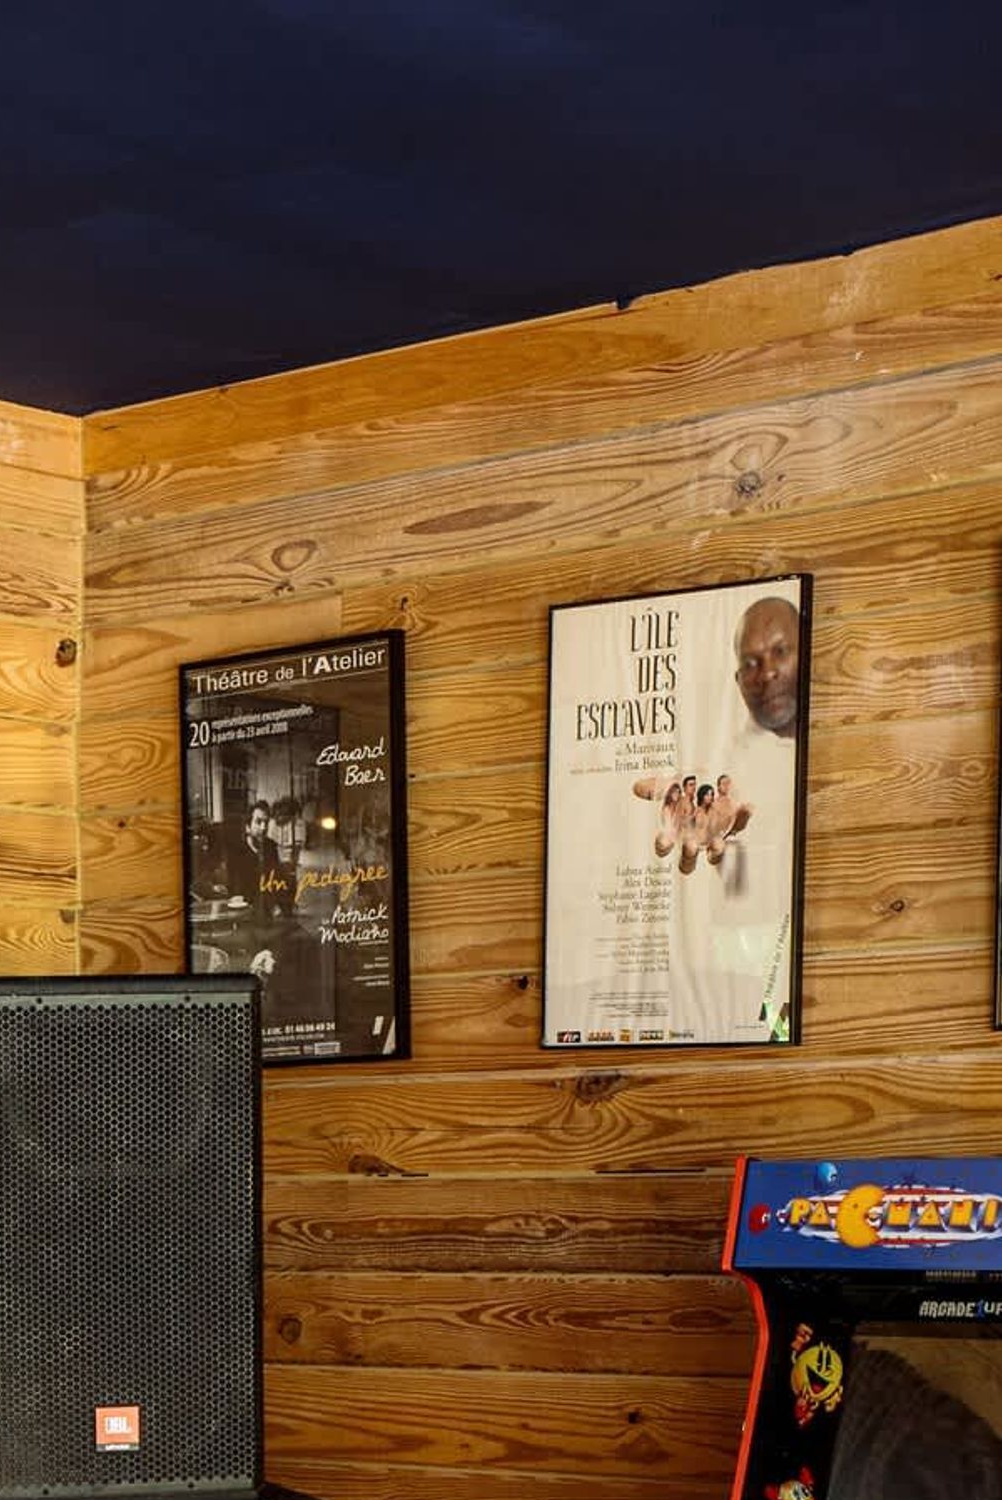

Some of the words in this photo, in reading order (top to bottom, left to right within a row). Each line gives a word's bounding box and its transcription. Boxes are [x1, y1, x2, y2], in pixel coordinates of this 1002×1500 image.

[191, 668, 268, 694] Théâtre
[275, 665, 294, 681] de
[302, 647, 386, 677] l'Atelier
[638, 653, 677, 693] DES
[577, 696, 676, 741] ESCLAVES
[189, 721, 211, 747] 20
[344, 764, 386, 786] Baer
[259, 868, 288, 892] Un
[331, 903, 389, 924] Patrick
[319, 925, 389, 944] Modiano
